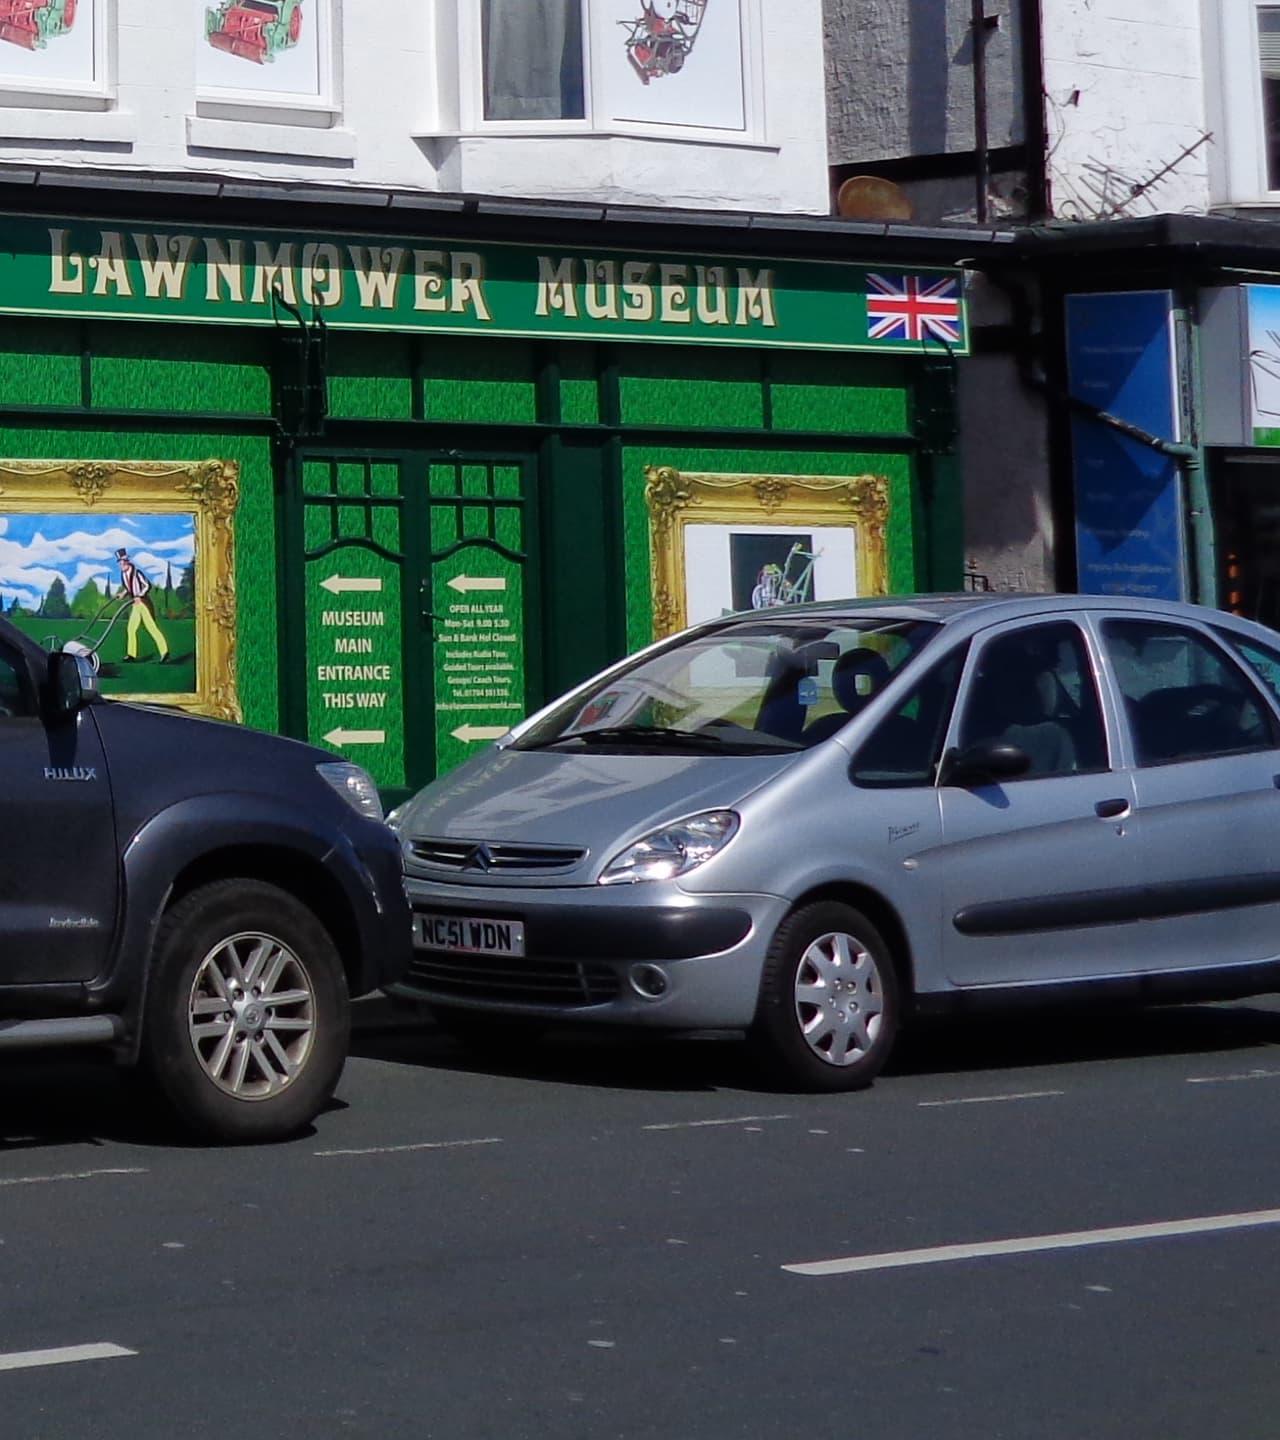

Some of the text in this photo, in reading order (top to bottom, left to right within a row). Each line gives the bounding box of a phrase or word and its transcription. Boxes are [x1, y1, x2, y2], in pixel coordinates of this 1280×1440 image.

[47, 227, 495, 322] LAWNMOWER
[535, 256, 778, 328] MUSEUM
[448, 604, 504, 613] OPEN ALL YEAR
[321, 611, 384, 626] MUSEUM
[460, 633, 478, 642] Bank
[335, 638, 372, 653] MAIN
[317, 665, 390, 680] ENTRANCE
[322, 692, 386, 708] THIS WAY
[43, 767, 96, 781] HILUX
